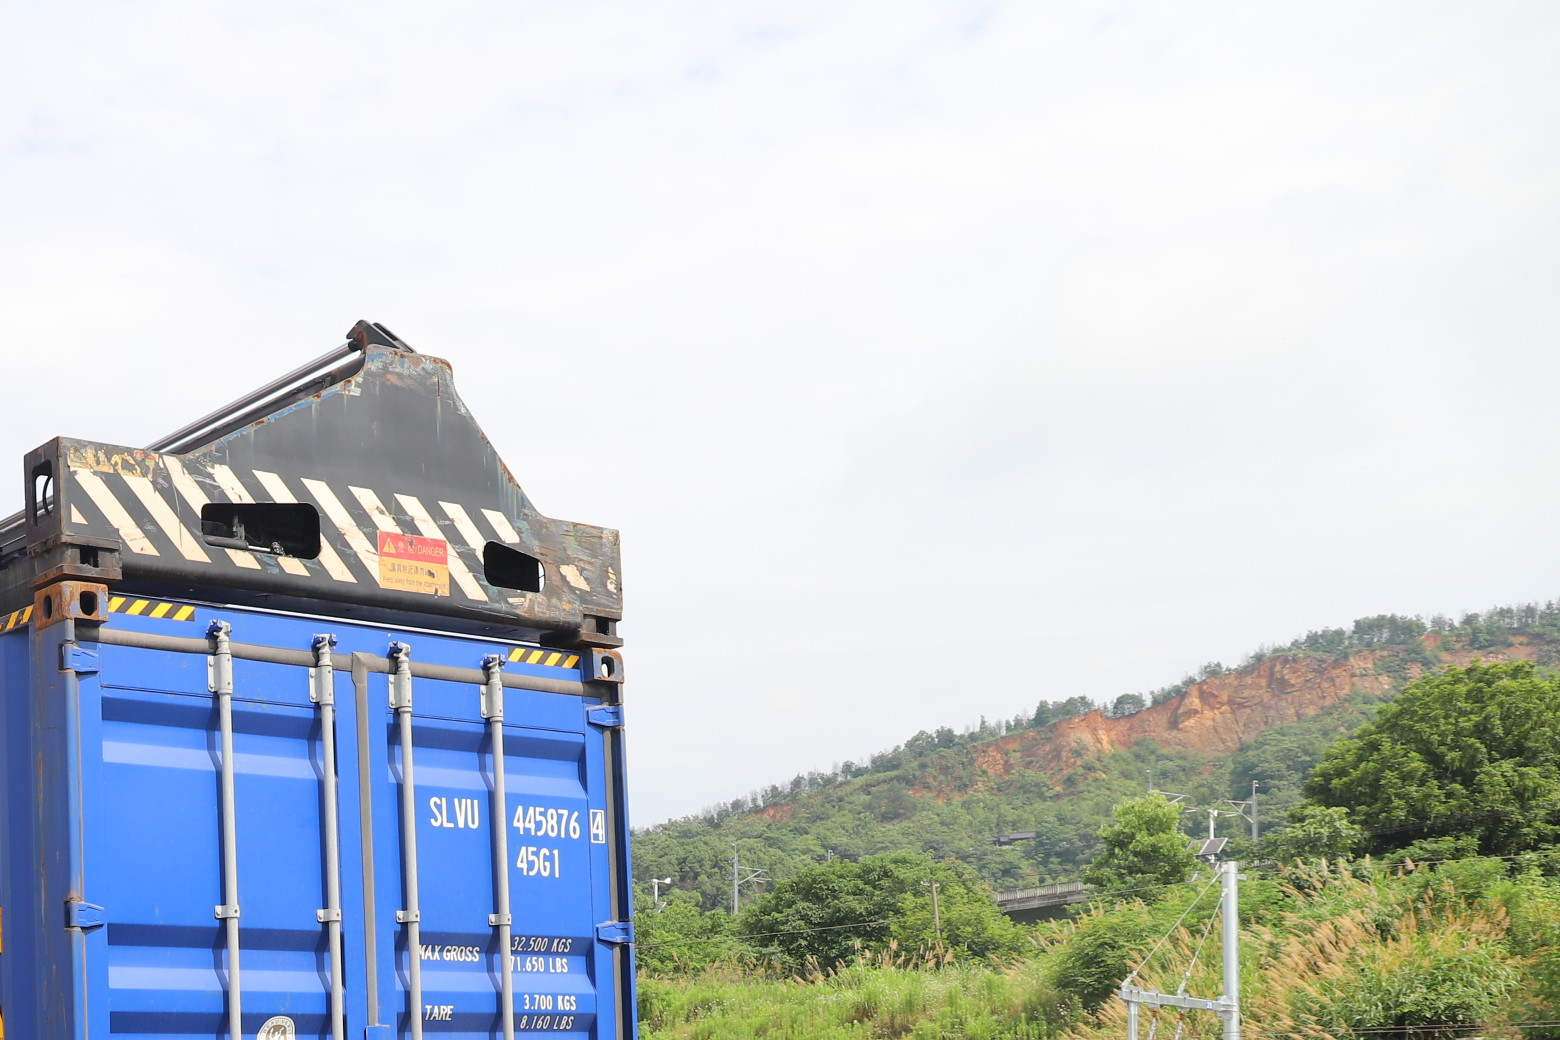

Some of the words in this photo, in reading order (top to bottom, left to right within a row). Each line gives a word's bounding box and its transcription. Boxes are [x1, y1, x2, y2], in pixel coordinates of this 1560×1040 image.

[429, 796, 480, 829] SLVU
[513, 805, 581, 839] 445876
[591, 811, 604, 842] 4
[516, 846, 560, 878] 45G1
[512, 936, 548, 951] 32.500
[551, 938, 573, 952] KGS
[418, 944, 441, 960] MAX
[443, 945, 480, 962] GROSS
[510, 956, 545, 972] 71.650
[549, 957, 569, 973] LBS
[523, 994, 553, 1010] 3.700
[557, 995, 577, 1011] KGS
[425, 1004, 454, 1021] TARE
[520, 1015, 550, 1030] 8.160
[553, 1015, 575, 1030] LBS
